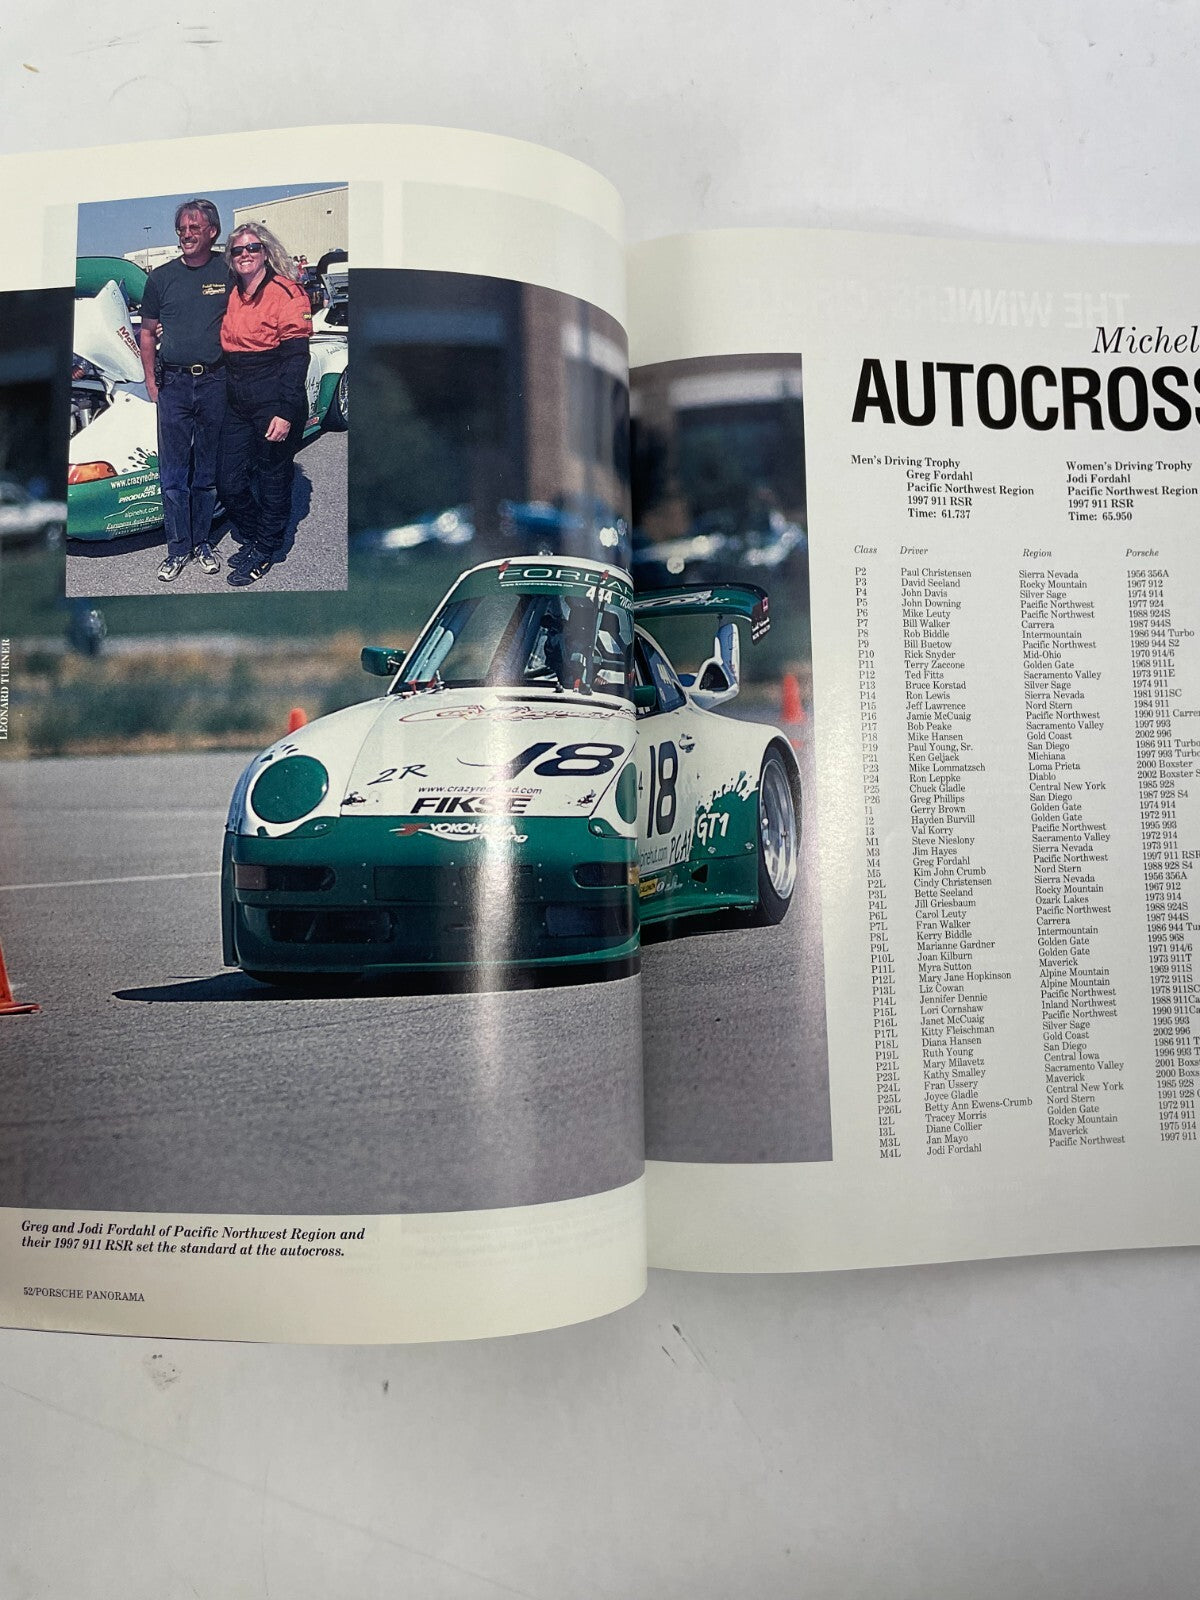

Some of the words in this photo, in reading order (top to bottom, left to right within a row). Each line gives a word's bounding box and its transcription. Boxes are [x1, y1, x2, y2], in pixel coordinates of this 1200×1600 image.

[1091, 326, 1200, 354] Michel
[851, 358, 1200, 432] AUTOCROS
[851, 454, 882, 465] Men's
[884, 455, 922, 468] Driving
[924, 457, 960, 470] Trophy
[1066, 461, 1112, 471] Women's
[1114, 461, 1154, 472] Driving
[1155, 460, 1192, 472] Trophy
[906, 469, 931, 482] Greg
[934, 470, 973, 481] Fordahl
[1066, 474, 1088, 483] Jodi
[1090, 474, 1131, 483] Fordahl
[907, 482, 942, 492] Pacific
[944, 483, 996, 494] Northwest
[999, 485, 1034, 496] Region
[1067, 486, 1103, 496] Pacific
[1106, 486, 1159, 496] Northwest
[1161, 485, 1198, 497] Region
[118, 490, 156, 503] PRODUCTS
[908, 495, 929, 505] 1997
[931, 496, 946, 506] 911
[950, 496, 973, 506] RSR
[1068, 499, 1089, 508] 1997
[1092, 499, 1107, 508] 911
[1111, 498, 1134, 508] RSR
[907, 508, 936, 518] Time:
[941, 509, 971, 519] 61.737
[1068, 511, 1097, 521] Time:
[1102, 511, 1132, 521] 65.950
[854, 544, 878, 554] Class
[900, 546, 928, 555] Driver
[1022, 548, 1052, 559] Region
[1125, 548, 1159, 557] Porsche
[855, 566, 867, 576] P2
[900, 567, 920, 577] Paul
[921, 568, 972, 578] Christensen
[1018, 569, 1045, 579] Sierra
[1047, 570, 1079, 579] Nevada
[1127, 570, 1146, 578] 1956
[1147, 569, 1170, 578] 356A
[856, 598, 868, 606] P5
[901, 598, 922, 607] John
[924, 598, 962, 610] Downing
[1020, 600, 1048, 609] Pacific
[1050, 600, 1095, 609] Northwest
[1128, 599, 1148, 608] 1977
[1149, 599, 1164, 608] 924
[1, 638, 10, 684] TURNER
[858, 660, 874, 669] P11
[904, 659, 929, 672] Terry
[931, 660, 965, 669] Zaccone
[1023, 660, 1052, 669] Golden
[1054, 660, 1075, 669] Gate
[1132, 659, 1151, 668] 1968
[1152, 658, 1175, 668] 911L
[905, 701, 923, 710] Jeff
[925, 701, 966, 710] Lawrence
[1025, 700, 1047, 710] Nord
[1049, 700, 1073, 710] Stern
[1134, 700, 1153, 708] 1984
[1154, 699, 1169, 708] 911
[0, 686, 9, 740] LEONARD
[647, 740, 679, 839] 18
[909, 784, 937, 794] Chuck
[938, 782, 966, 793] Gladle
[1029, 782, 1061, 792] Central
[1063, 782, 1083, 791] New
[1084, 781, 1106, 790] York
[1138, 780, 1158, 789] 1985
[1159, 780, 1175, 788] 928
[697, 812, 730, 846] GT1
[911, 824, 927, 835] Val
[928, 825, 954, 836] Korry
[1031, 823, 1060, 832] Pacific
[1061, 822, 1107, 832] Northwest
[1140, 820, 1160, 830] 1995
[1162, 820, 1178, 829] 993
[1035, 894, 1061, 905] Ozark
[1063, 894, 1089, 904] Lakes
[1145, 892, 1165, 902] 1973
[1166, 892, 1182, 901] 914
[868, 900, 887, 910] P4L
[914, 899, 928, 909] Jill
[930, 898, 976, 908] Griesbaum
[870, 943, 889, 952] P9L
[916, 941, 958, 951] Marianne
[959, 939, 996, 950] Gardner
[1148, 944, 1167, 953] 1971
[1170, 943, 1193, 952] 914/6
[1038, 947, 1068, 957] Golden
[1070, 946, 1090, 956] Gate
[1153, 1016, 1173, 1026] 1995
[1174, 1016, 1190, 1025] 993
[875, 1039, 899, 1050] P18L
[921, 1038, 948, 1047] Diana
[949, 1036, 982, 1046] Hansen
[1043, 1042, 1060, 1052] San
[1062, 1041, 1087, 1053] Diego
[876, 1072, 900, 1082] P23L
[923, 1070, 950, 1080] Kathy
[952, 1067, 986, 1078] Smalley
[1045, 1072, 1085, 1084] Maverick
[1157, 1079, 1177, 1088] 1985
[1178, 1079, 1194, 1088] 928
[1049, 1137, 1078, 1148] Pacific
[1079, 1135, 1126, 1146] Northwest
[1160, 1132, 1180, 1142] 1997
[1182, 1131, 1197, 1141] 911
[880, 1148, 902, 1159] M4L
[926, 1145, 946, 1156] Jodi
[947, 1143, 982, 1154] Fordahl
[21, 1220, 49, 1234] Greg
[52, 1222, 75, 1234] and
[77, 1222, 104, 1234] Jodi
[106, 1223, 156, 1236] Fordahl
[158, 1225, 172, 1237] of
[173, 1225, 219, 1238] Pacific
[221, 1226, 287, 1240] Northwest
[290, 1228, 336, 1242] Region
[340, 1227, 366, 1240] and
[22, 1236, 52, 1248] their
[54, 1238, 80, 1249] 1997
[82, 1238, 102, 1250] 911
[104, 1239, 133, 1252] RSR
[136, 1241, 154, 1252] set
[157, 1241, 177, 1253] the
[180, 1242, 237, 1255] standard
[240, 1244, 253, 1256] at
[256, 1244, 277, 1256] the
[280, 1244, 344, 1256] autocross.
[23, 1286, 84, 1299] 52/PORSCHE
[86, 1290, 145, 1302] PANORAMA
